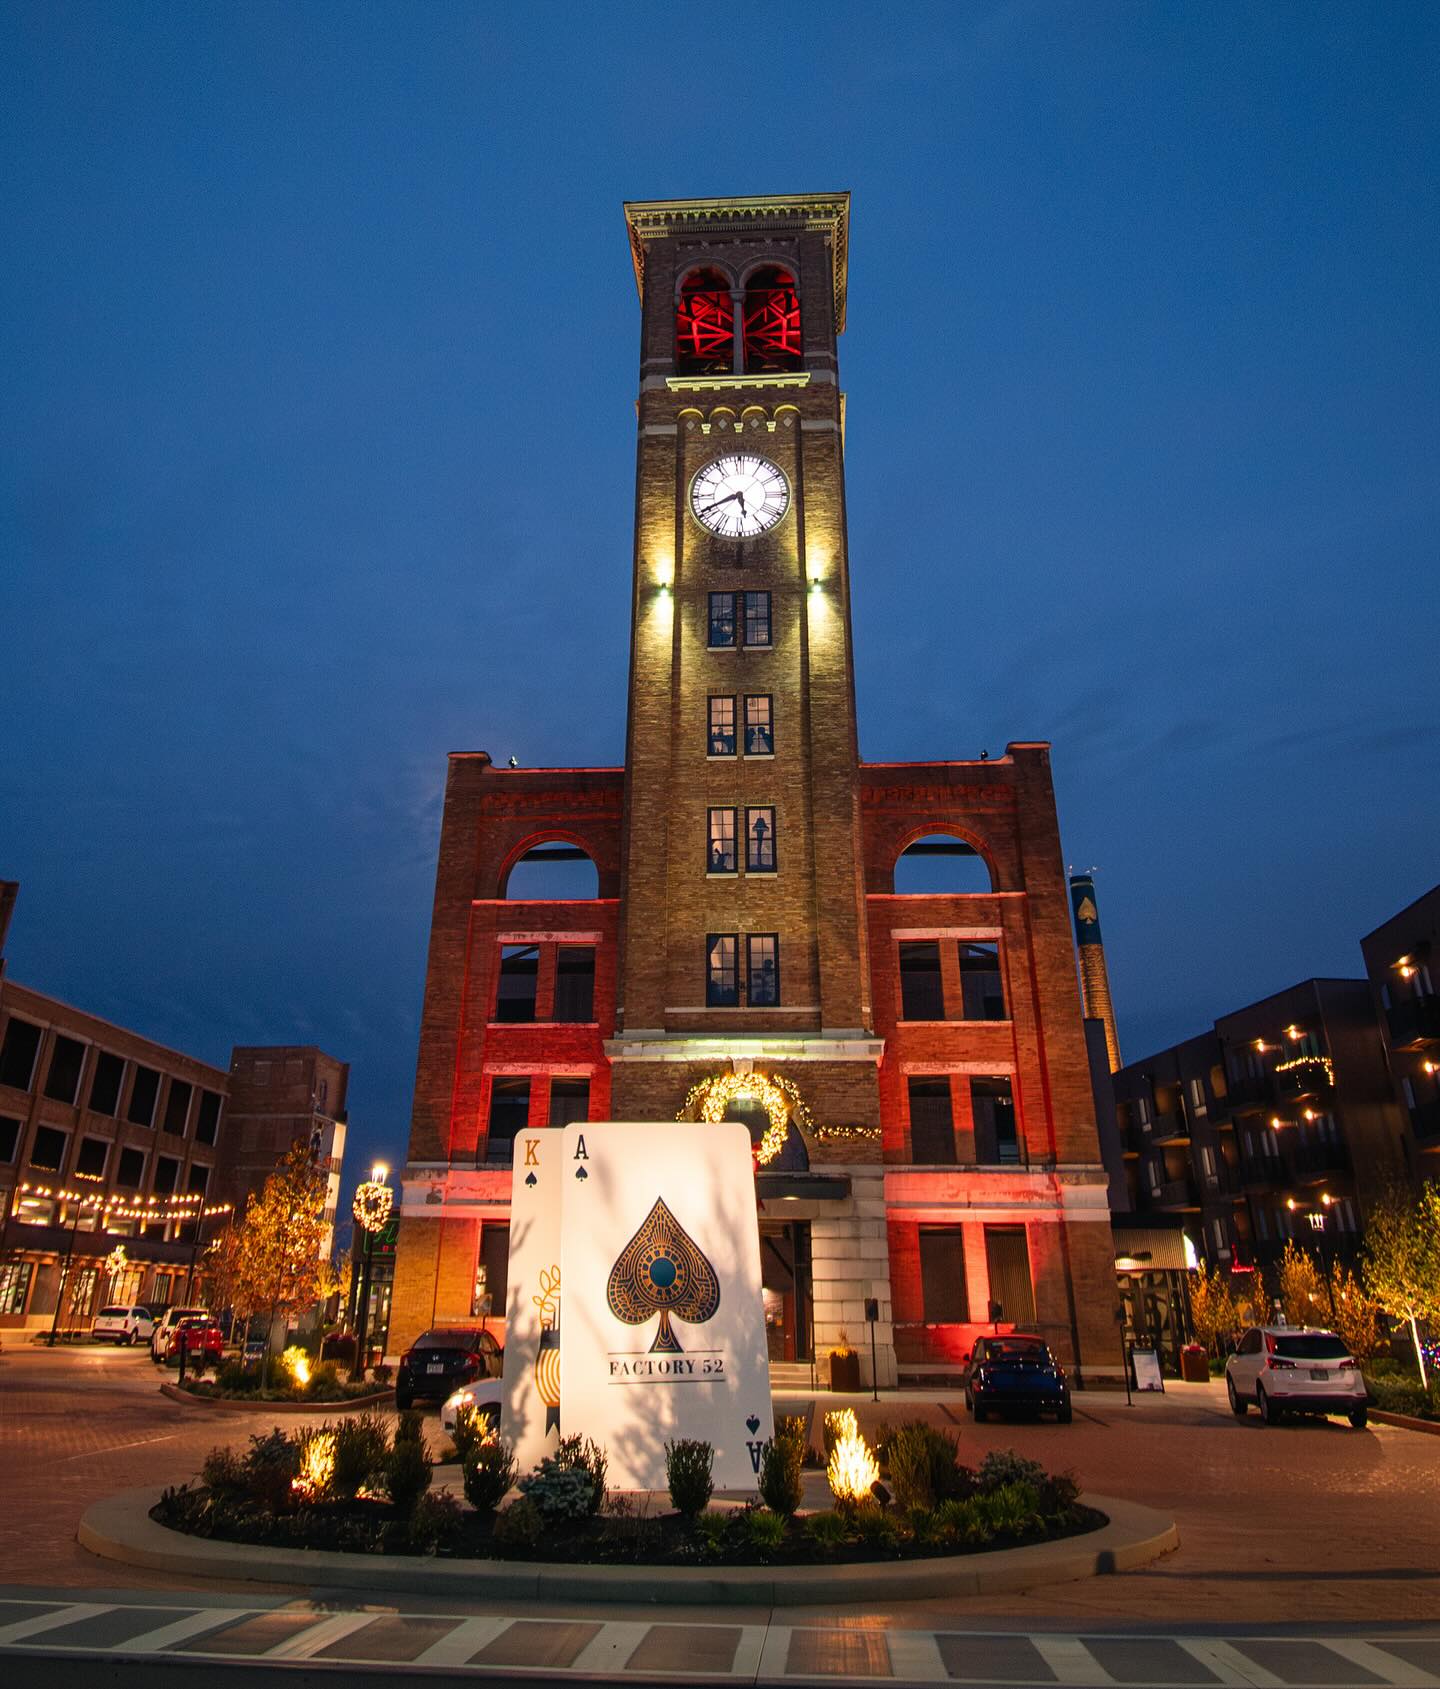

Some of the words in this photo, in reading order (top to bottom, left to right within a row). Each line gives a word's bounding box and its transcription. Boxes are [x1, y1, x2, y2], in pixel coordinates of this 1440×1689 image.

[525, 1139, 540, 1166] K
[574, 1134, 589, 1160] A
[609, 1360, 695, 1376] FACTORY
[703, 1359, 724, 1374] 52
[746, 1441, 763, 1473] A
